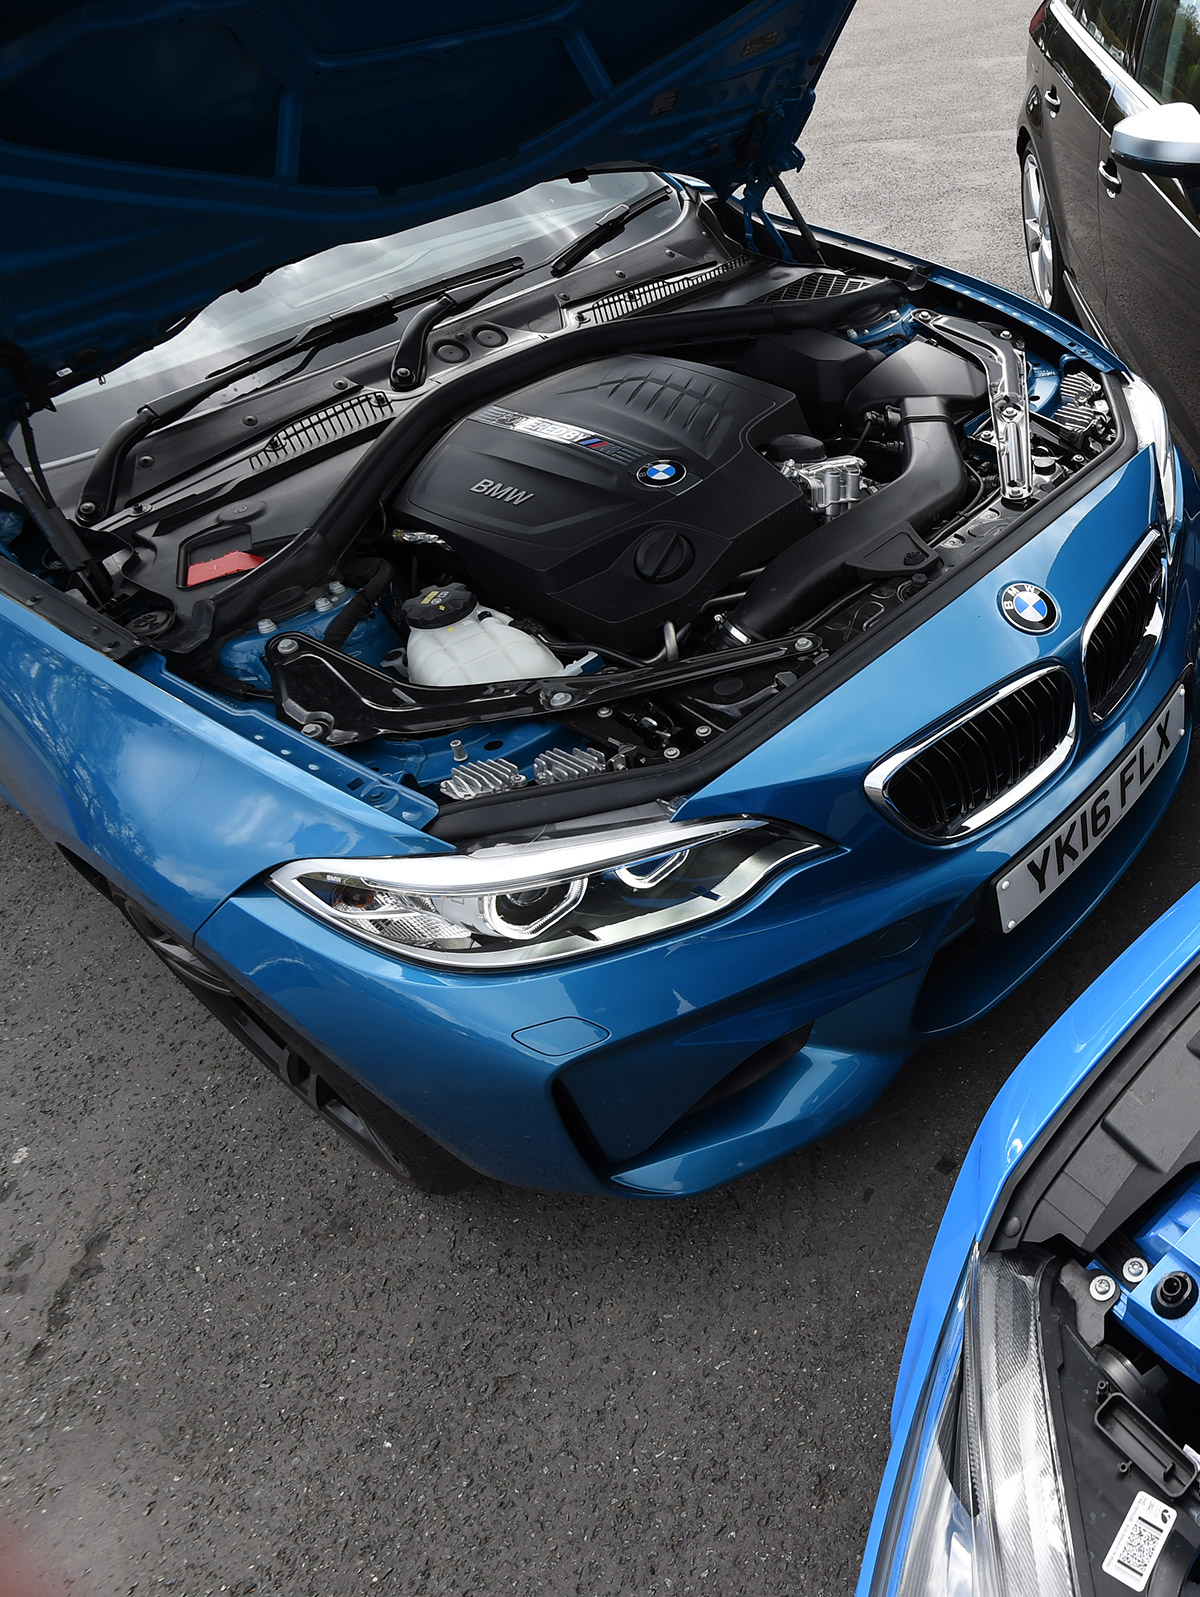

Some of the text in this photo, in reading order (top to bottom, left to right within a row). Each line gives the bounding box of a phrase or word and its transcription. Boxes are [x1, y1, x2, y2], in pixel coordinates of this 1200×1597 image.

[563, 428, 593, 443] BY
[469, 478, 534, 506] BMW
[1003, 584, 1036, 610] BMW
[1027, 710, 1171, 894] YK16 FLX
